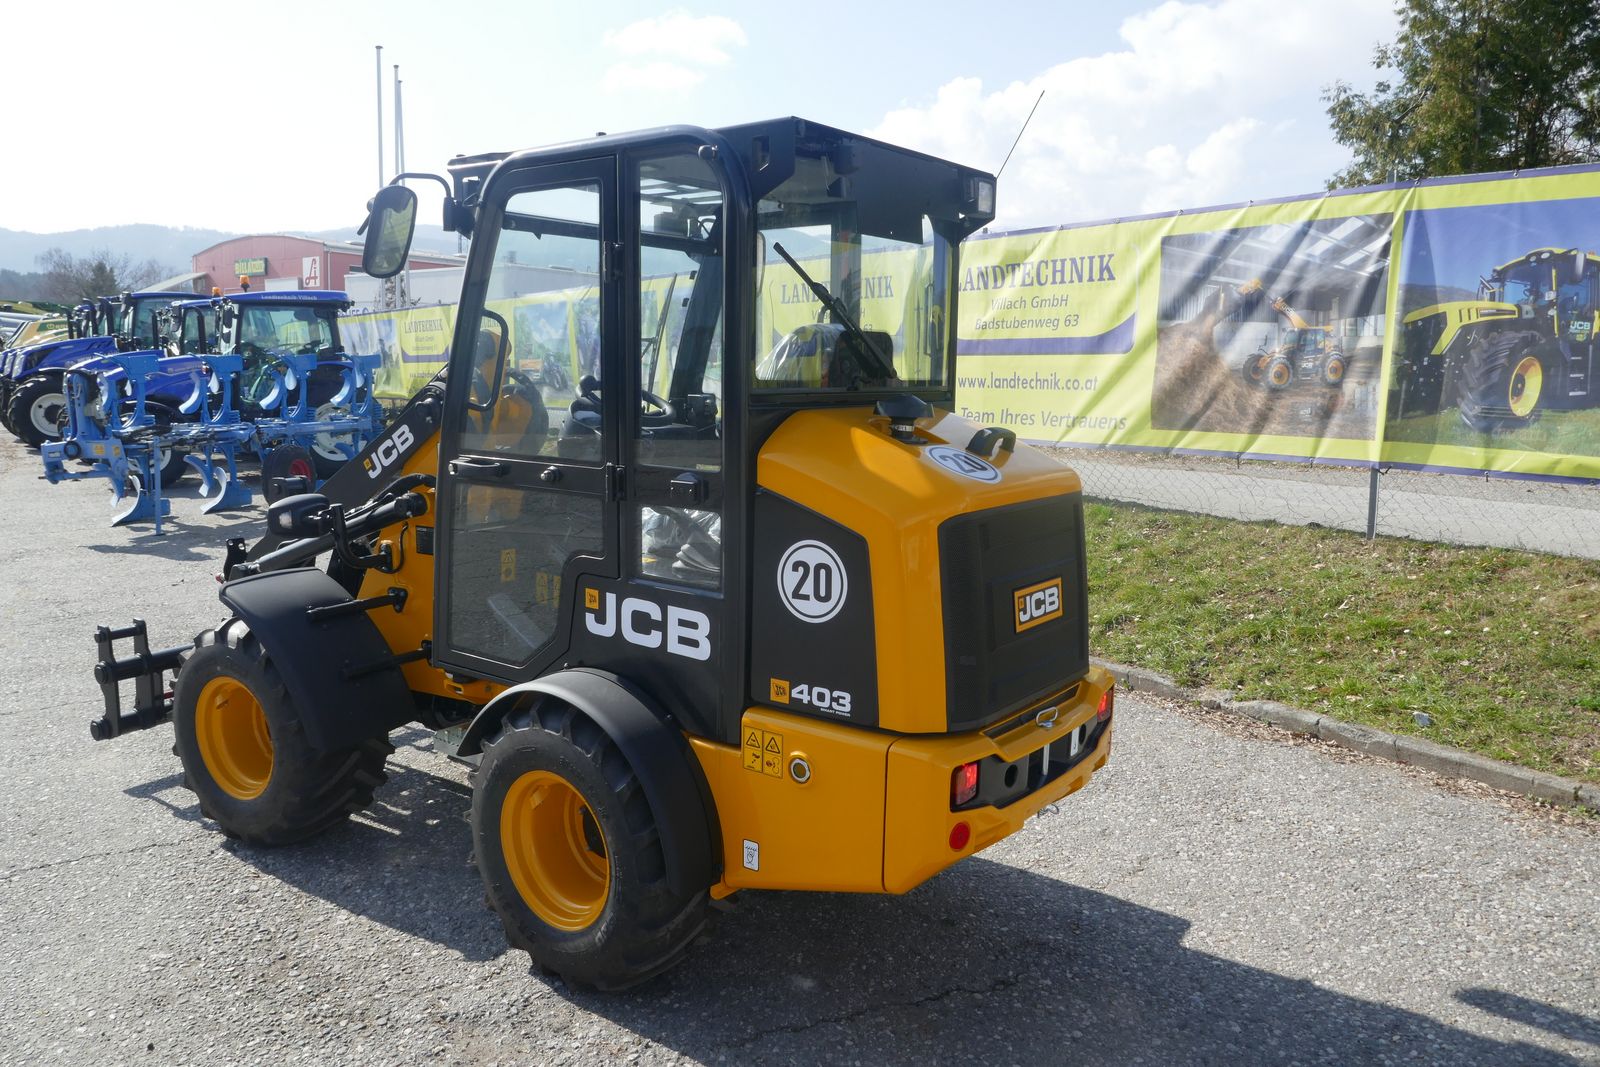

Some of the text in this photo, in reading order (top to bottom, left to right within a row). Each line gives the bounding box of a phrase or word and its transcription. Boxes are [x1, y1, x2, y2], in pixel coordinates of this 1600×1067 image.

[991, 294, 1069, 311] Villach GmbH
[975, 314, 1080, 331] Badstubenweg 63
[958, 372, 1098, 391] www.landtechnik.co.at
[961, 407, 1128, 431] Team Ihres Vertrauens
[367, 424, 415, 479] JCB
[938, 453, 988, 473] 20
[791, 560, 833, 603] 20
[1019, 586, 1060, 622] JCB
[586, 592, 712, 661] JCB
[791, 683, 852, 712] 403
